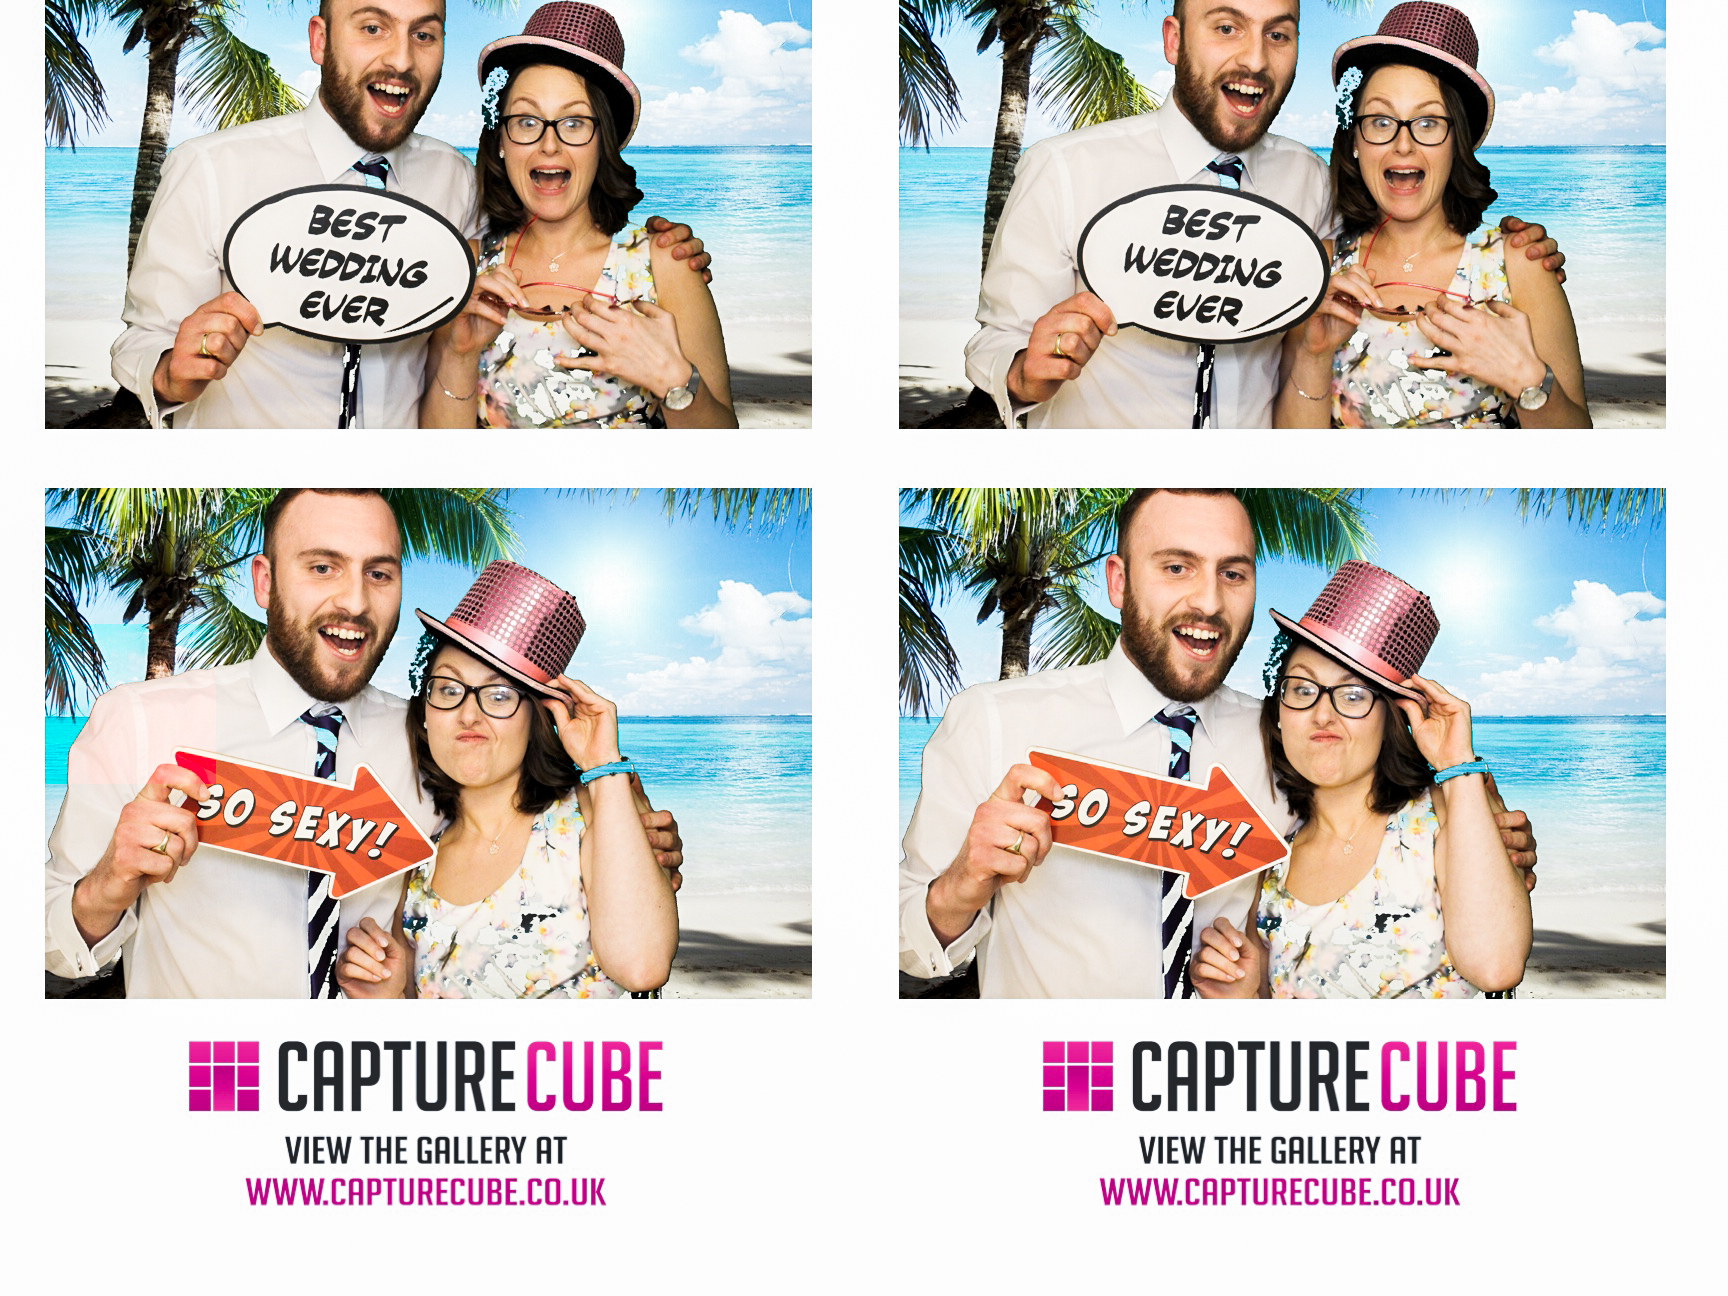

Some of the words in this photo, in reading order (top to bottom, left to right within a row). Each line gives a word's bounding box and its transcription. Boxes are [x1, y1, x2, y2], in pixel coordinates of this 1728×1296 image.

[308, 204, 407, 243] BEST
[1162, 204, 1261, 243] BEST
[270, 243, 428, 289] WEDDING
[1124, 243, 1282, 289] WEDDING
[299, 290, 389, 327] EVER
[1153, 290, 1243, 327] EVER
[196, 784, 256, 827] SO
[268, 800, 399, 860] SEXY!
[1050, 784, 1110, 827] SO
[1122, 800, 1253, 860] SEXY!
